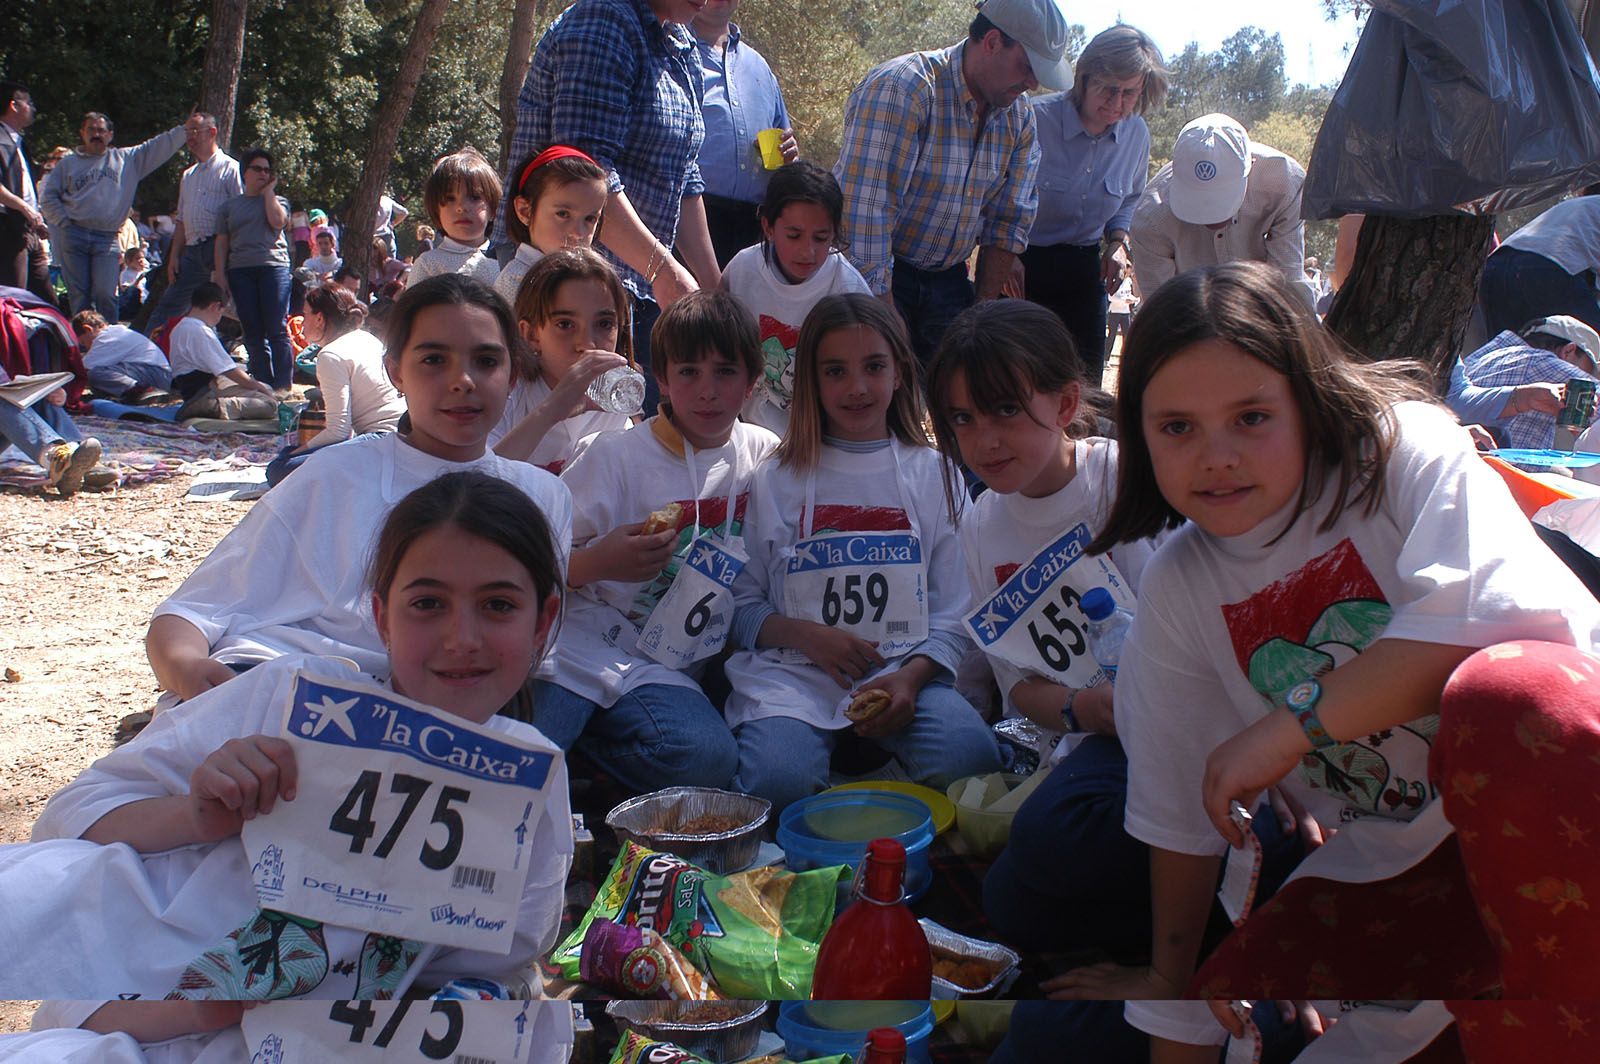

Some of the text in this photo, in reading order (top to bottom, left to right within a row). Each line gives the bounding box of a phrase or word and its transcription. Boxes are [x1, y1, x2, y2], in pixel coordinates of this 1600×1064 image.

[822, 572, 889, 626] 659
[328, 770, 471, 870] 475
[303, 877, 388, 902] DELPHI
